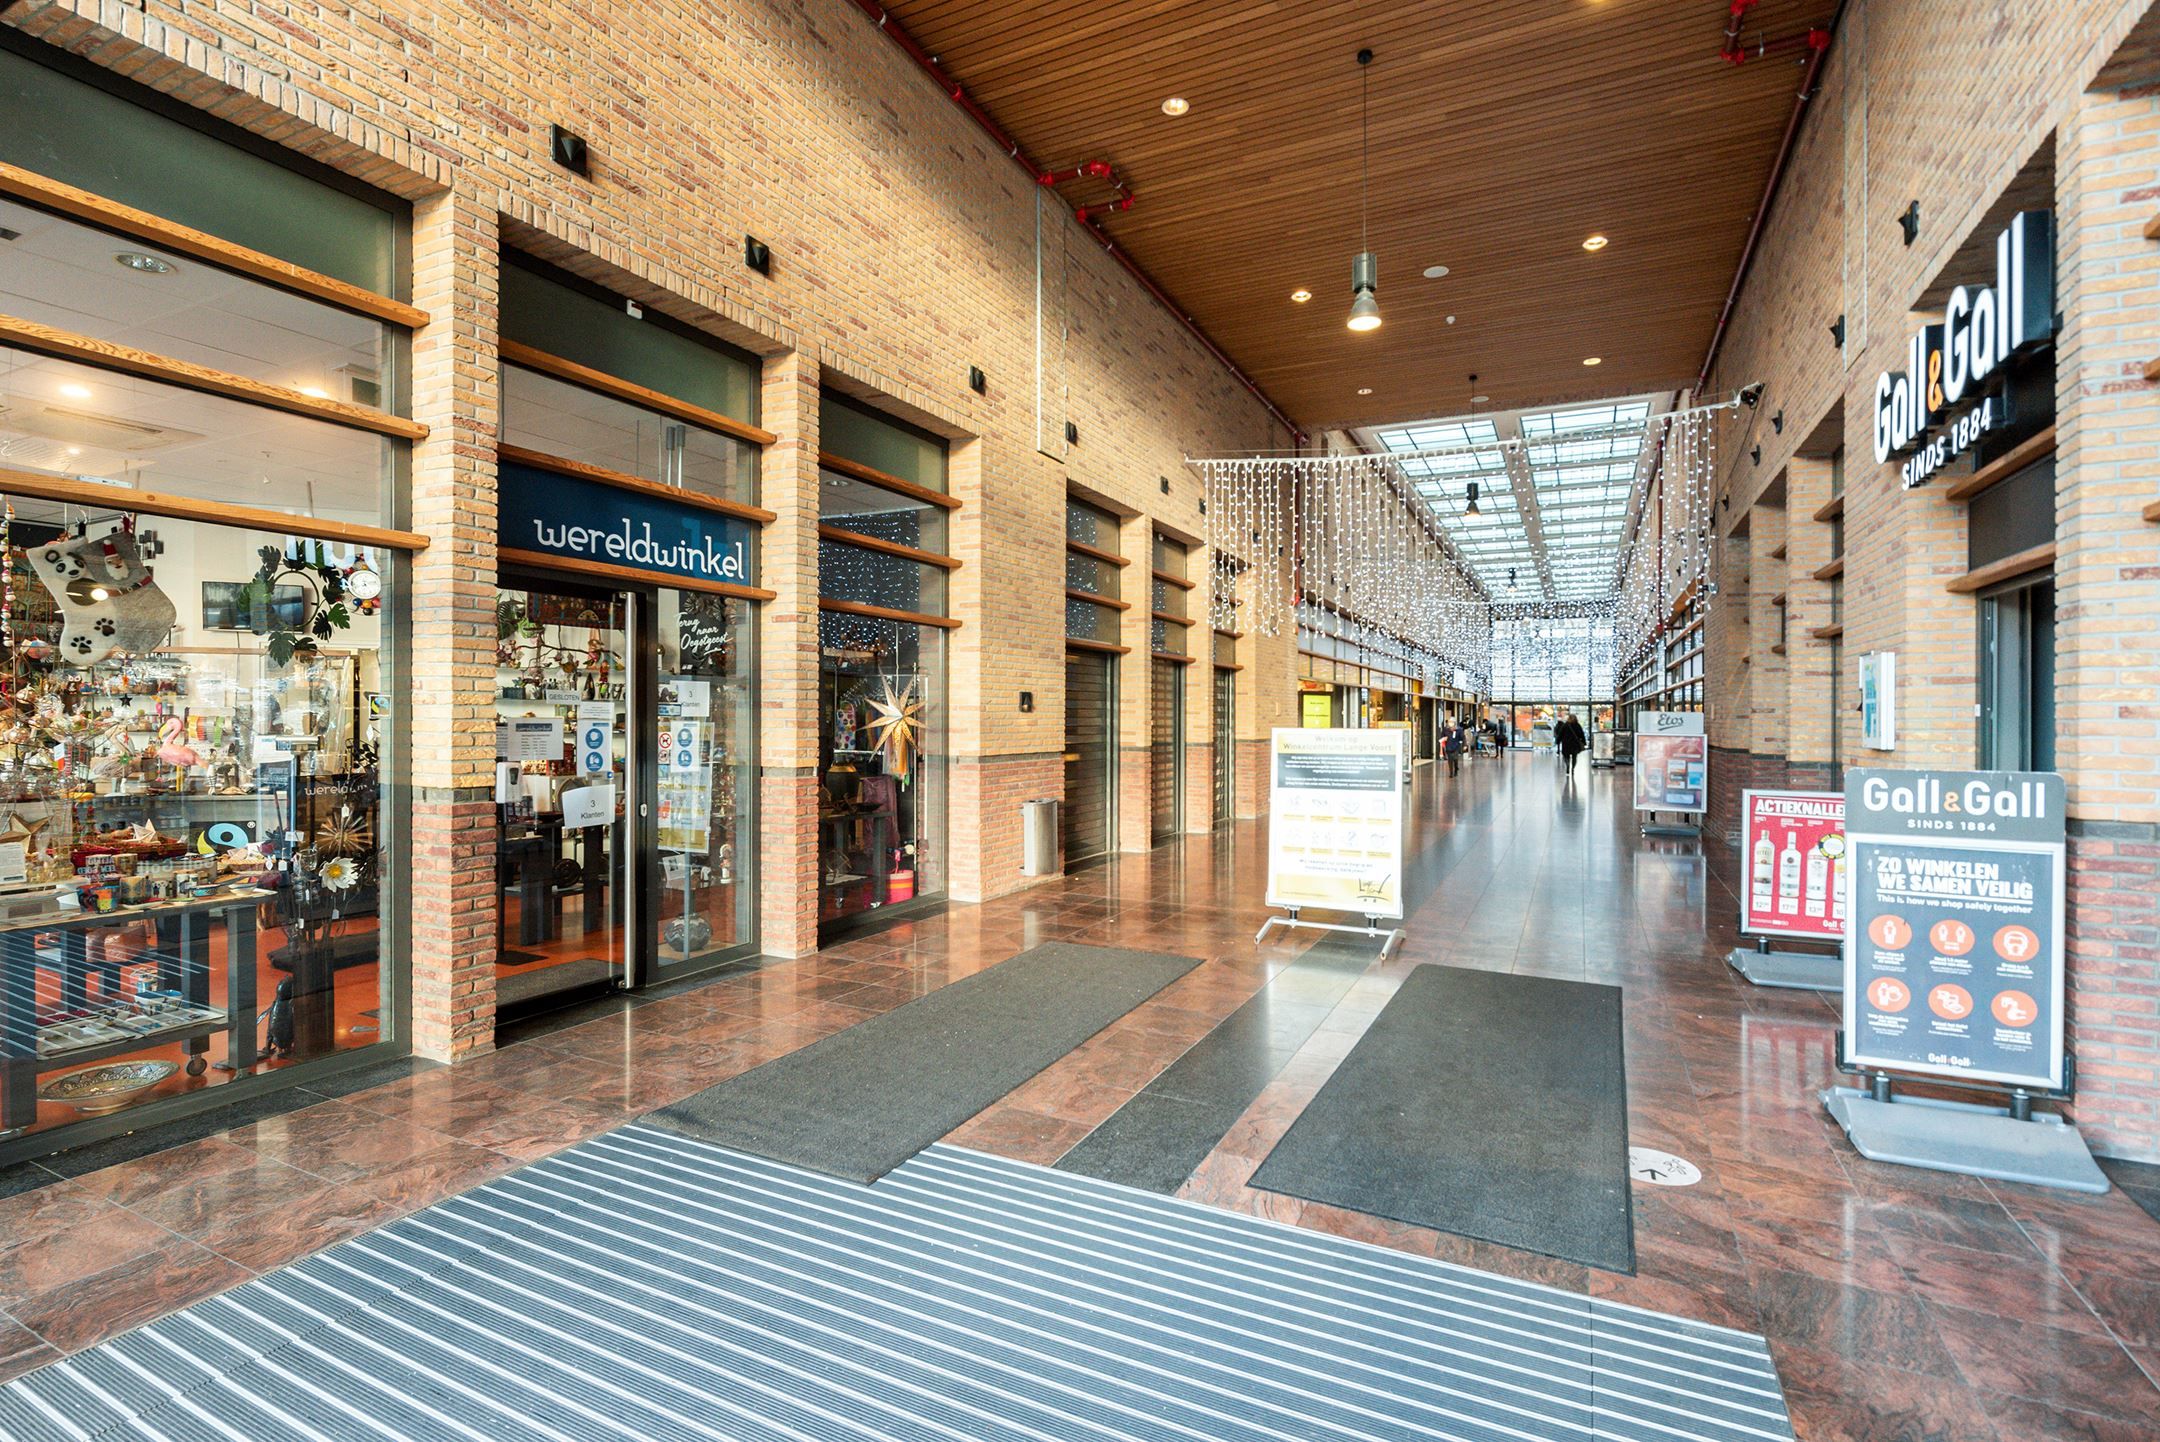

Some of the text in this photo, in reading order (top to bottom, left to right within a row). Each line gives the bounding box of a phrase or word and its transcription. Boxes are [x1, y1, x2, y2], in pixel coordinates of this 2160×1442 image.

[1902, 397, 1992, 491] SINDS 1884
[533, 517, 745, 580] wereldwinkel
[674, 611, 700, 632] Terug
[696, 626, 719, 635] naar
[680, 632, 734, 653] Oegstgeest
[548, 693, 580, 701] GESLOTEN
[1657, 713, 1684, 727] Etos
[1755, 799, 1845, 817] ACTIEKNALLE
[1863, 777, 2046, 819] Gall&Gall
[581, 811, 605, 819] Klanten
[1907, 819, 1997, 832] SINDS 1884
[1877, 856, 1999, 880] ZO WINKELEN
[1877, 872, 2033, 899] WE SAMEN VEILIG
[1876, 894, 1896, 903] This
[1906, 896, 1925, 906] how
[1926, 899, 1940, 907] we
[1941, 900, 1963, 910] shop
[1965, 901, 1992, 912] safely
[1993, 904, 2033, 914] together
